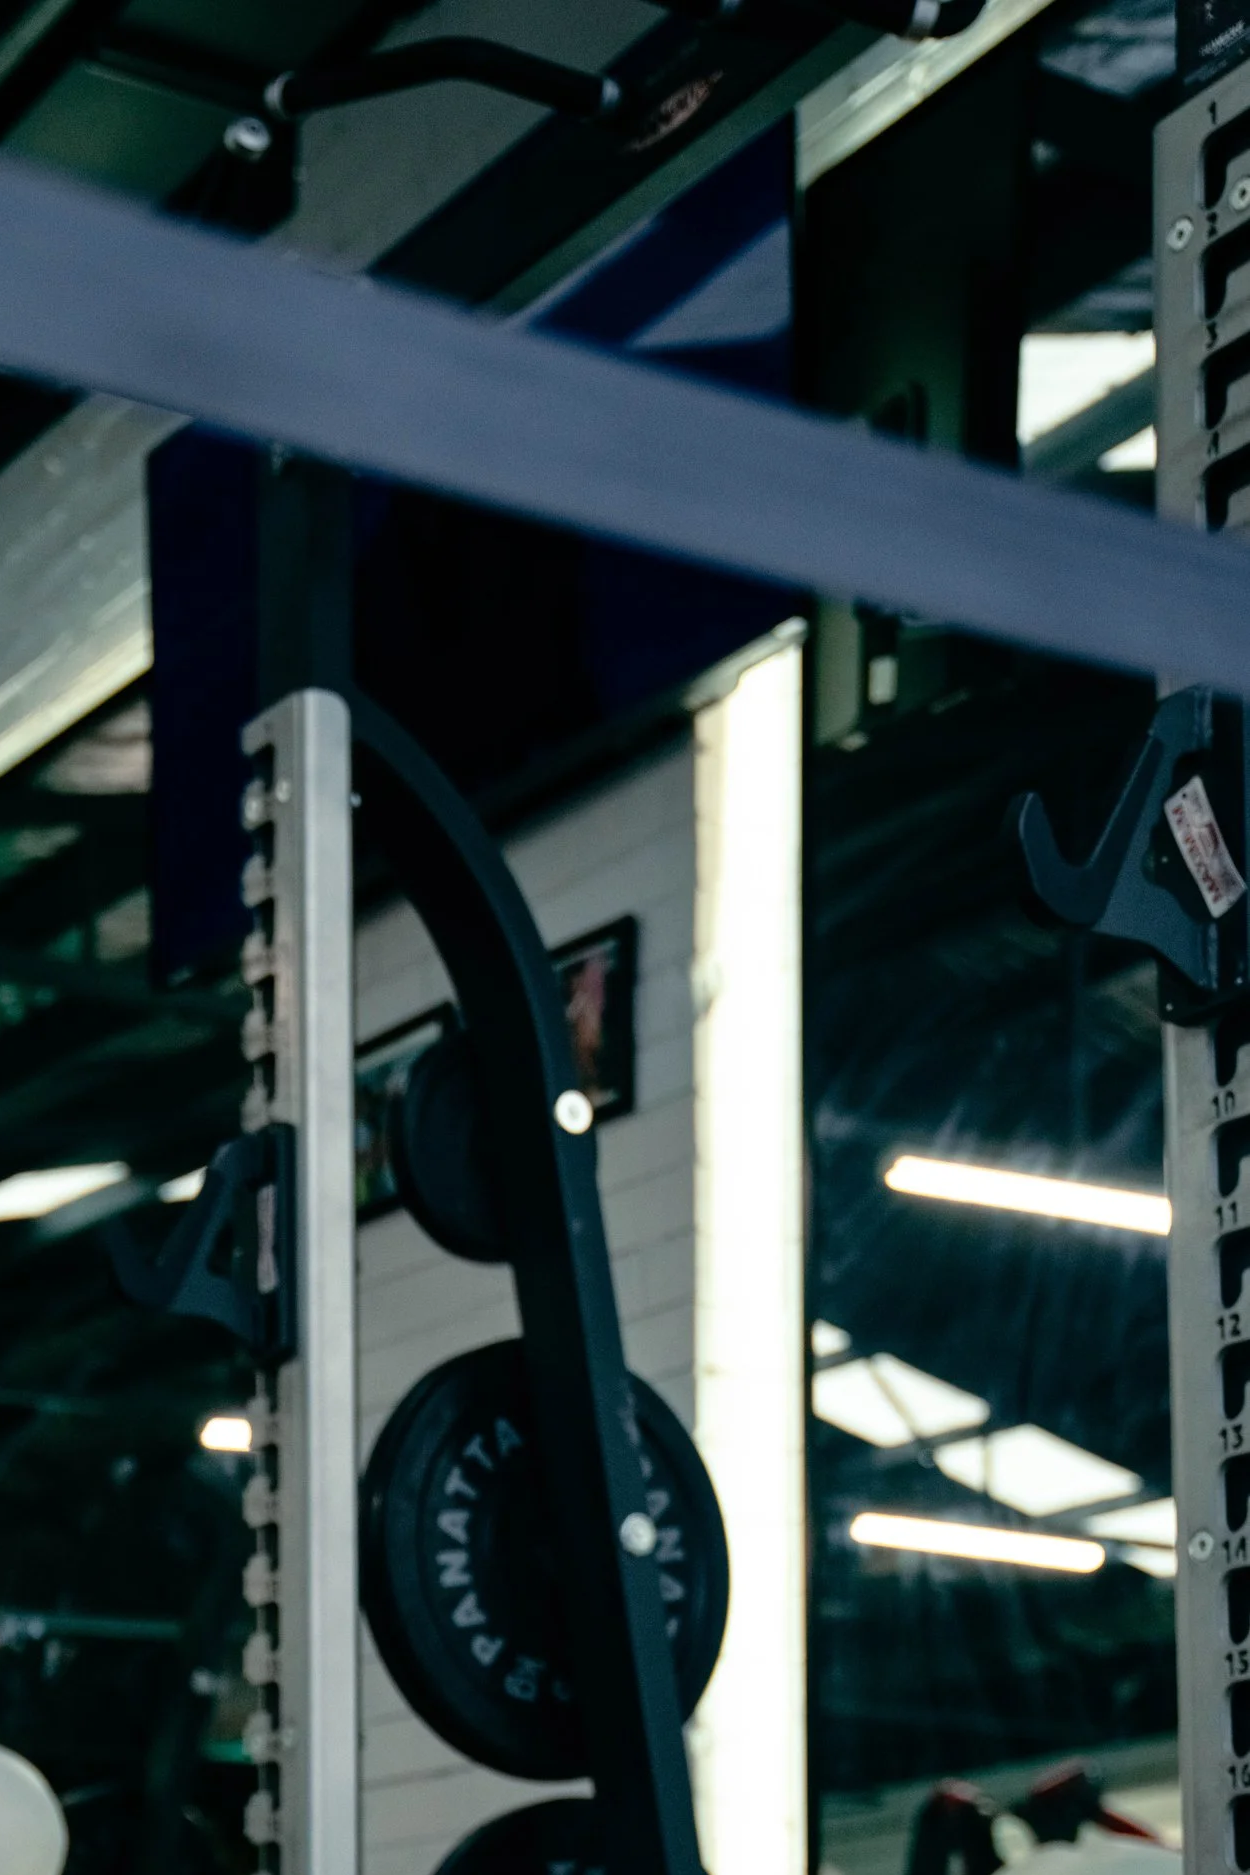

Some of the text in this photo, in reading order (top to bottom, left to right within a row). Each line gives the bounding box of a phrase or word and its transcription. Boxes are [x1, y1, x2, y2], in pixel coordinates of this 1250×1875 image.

[1207, 100, 1217, 125] 1
[1206, 321, 1218, 349] 3
[1212, 1089, 1236, 1119] 10
[1215, 1201, 1238, 1231] 11
[1216, 1313, 1241, 1340] 12
[1219, 1424, 1244, 1452] 13
[436, 1417, 523, 1667] PANATTA
[1222, 1536, 1247, 1564] 14
[1225, 1650, 1250, 1677] 15
